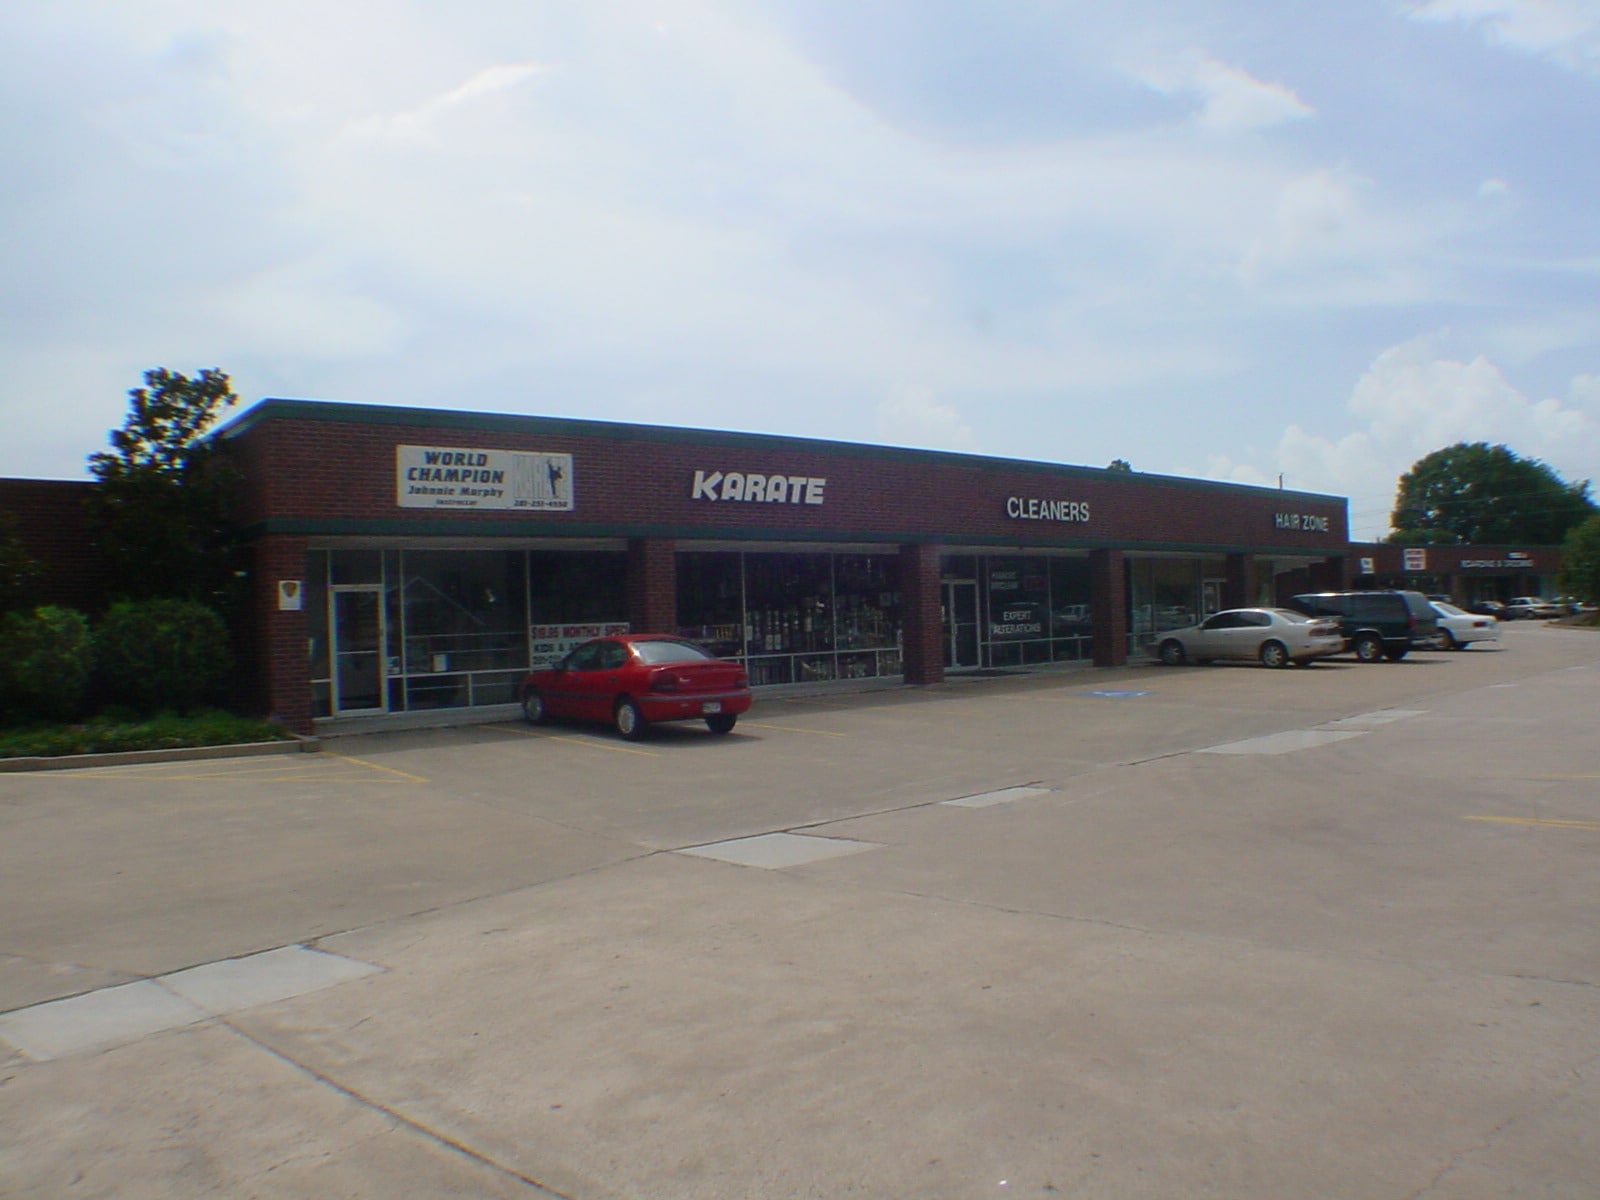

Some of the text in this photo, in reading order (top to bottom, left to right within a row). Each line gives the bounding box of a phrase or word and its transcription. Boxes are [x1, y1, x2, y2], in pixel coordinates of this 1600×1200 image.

[424, 451, 489, 467] WORLD
[407, 467, 504, 484] CHAMPION
[408, 485, 504, 498] Johnnie Murphy
[692, 470, 826, 505] KARATE
[1007, 496, 1090, 522] CLEANERS
[1275, 513, 1329, 532] HAIR ZONE
[1003, 610, 1031, 621] EXPERT
[993, 622, 1041, 634] ALTERATIONS
